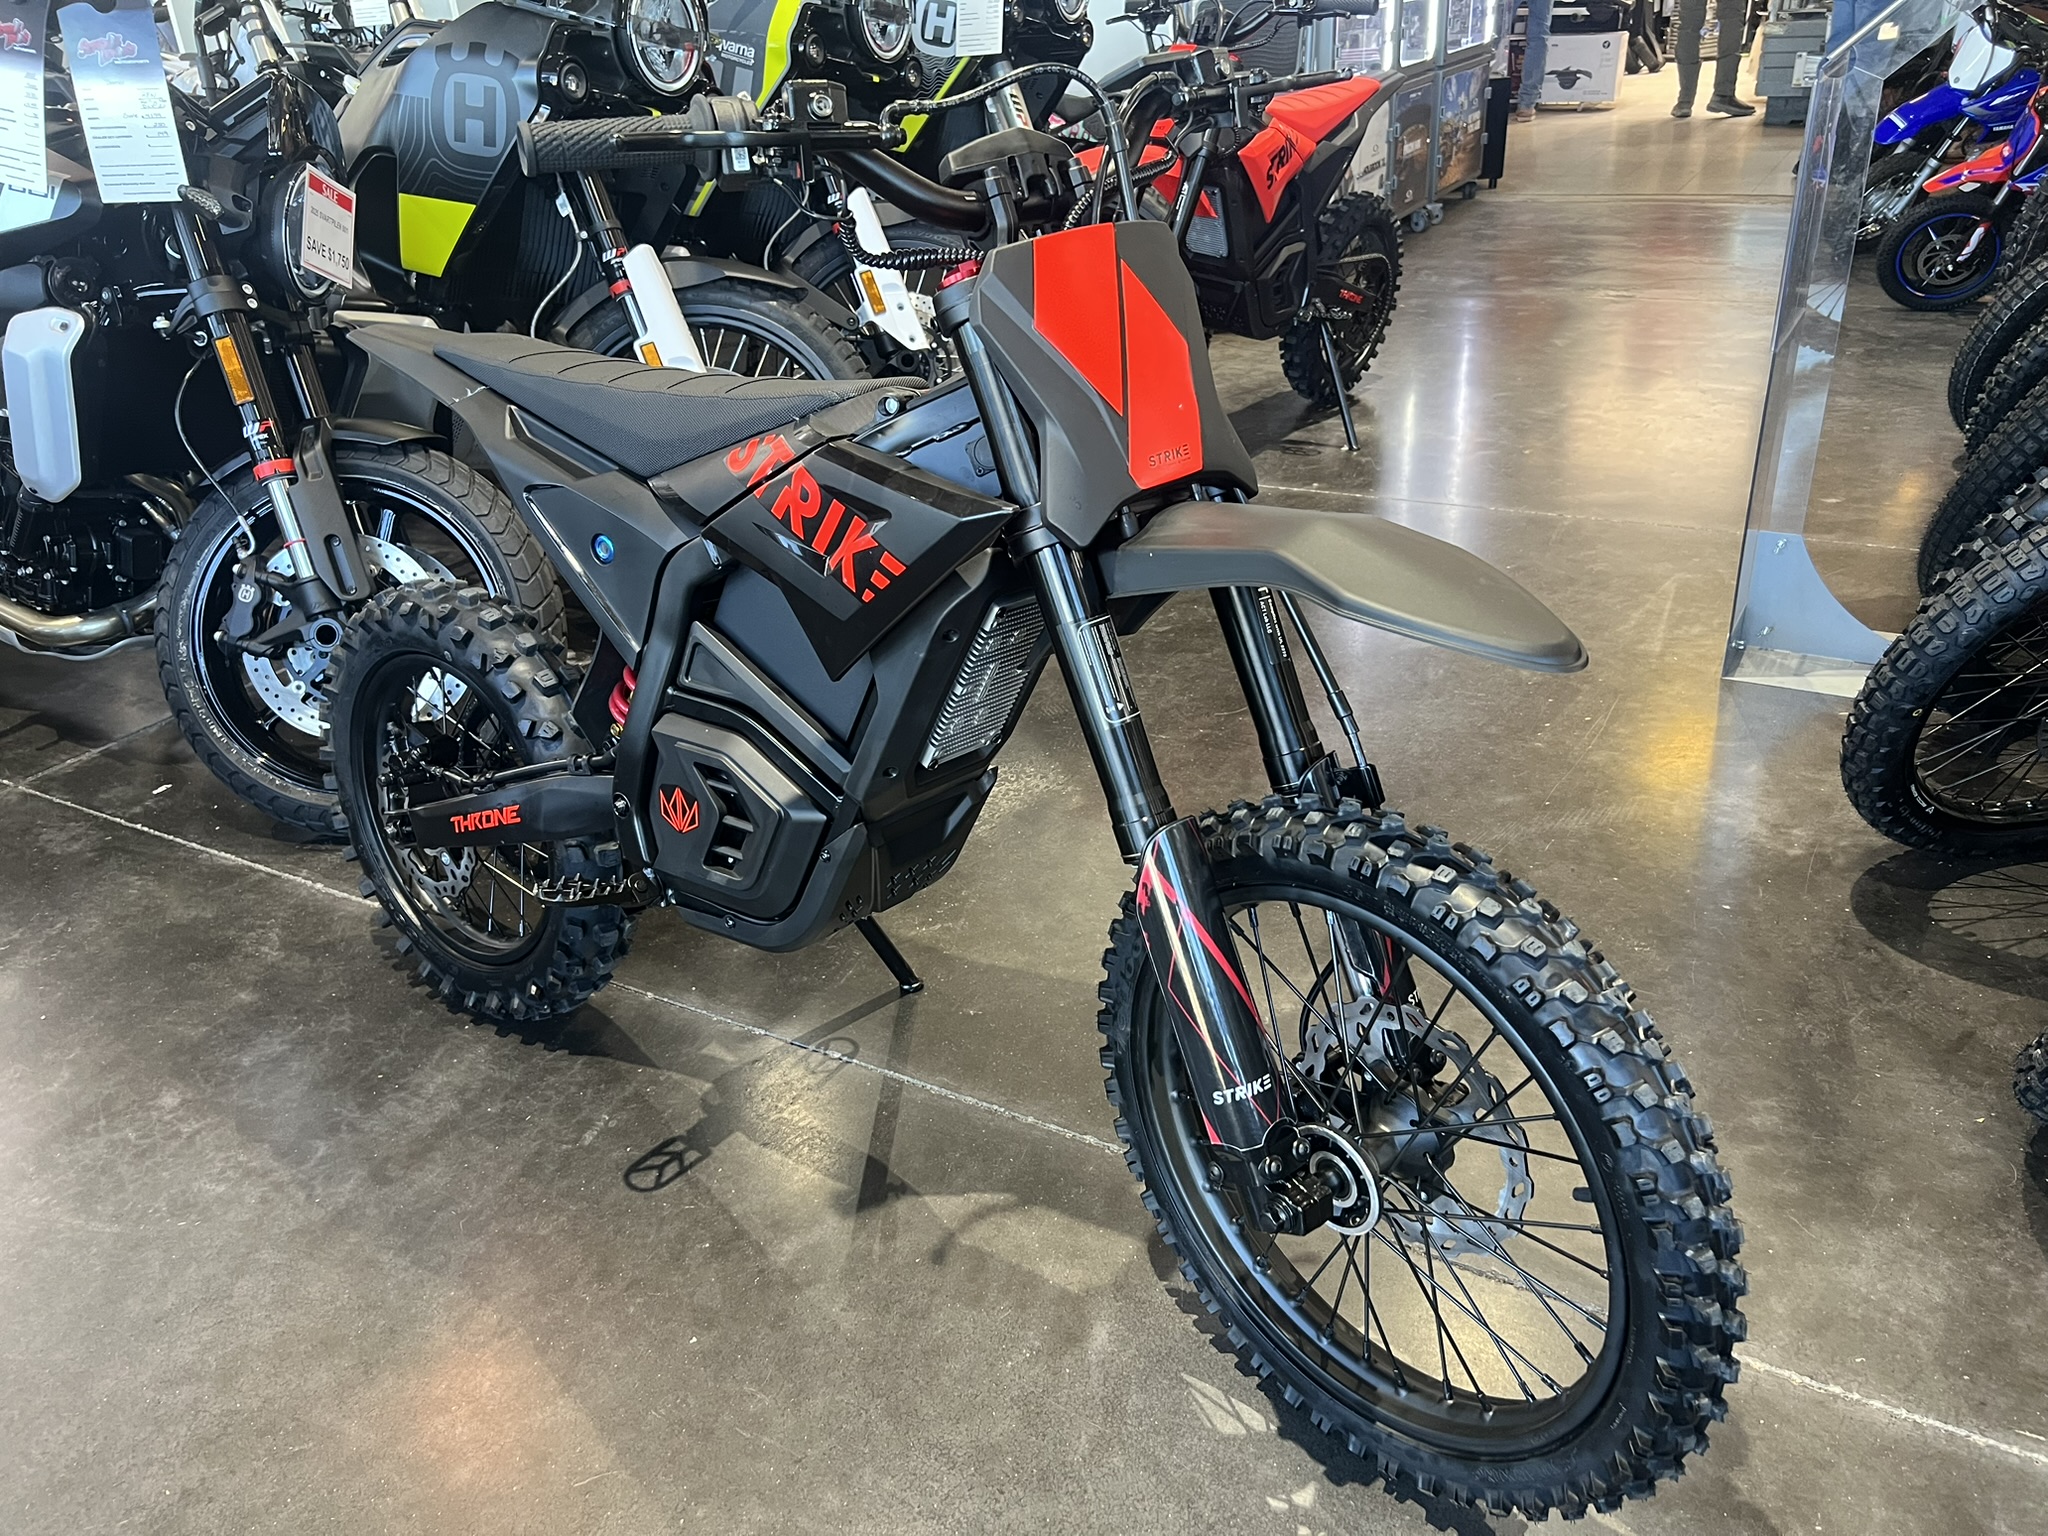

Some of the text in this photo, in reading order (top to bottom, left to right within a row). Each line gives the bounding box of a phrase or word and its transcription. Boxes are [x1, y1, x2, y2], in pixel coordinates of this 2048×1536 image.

[453, 81, 497, 148] H
[321, 184, 339, 204] SALE
[306, 236, 350, 270] SAVE $1,750
[1149, 444, 1189, 467] STRIKE
[723, 434, 906, 603] STRIKE
[450, 804, 521, 833] THRONE
[1212, 1073, 1272, 1106] STRIKE
